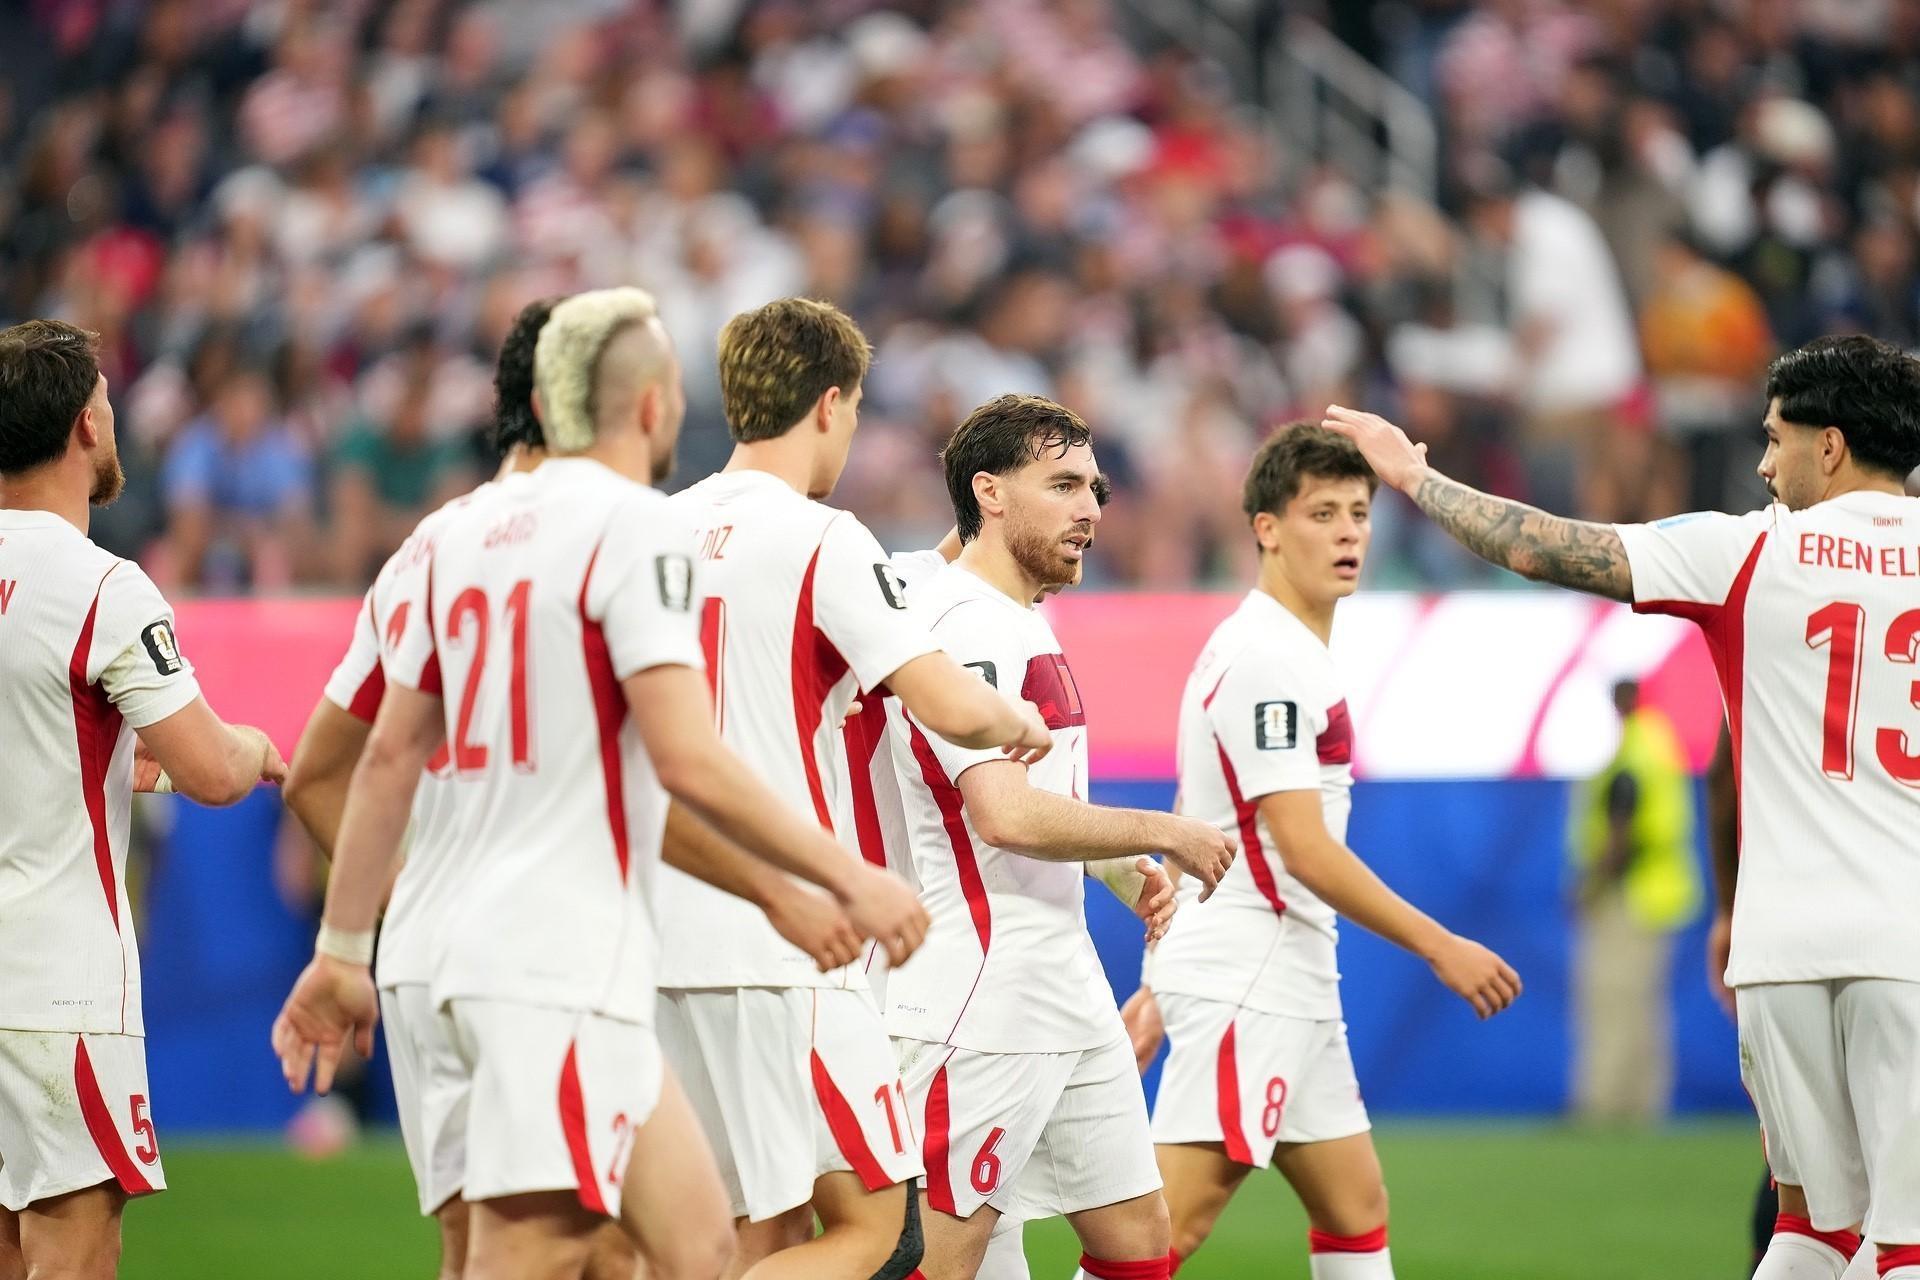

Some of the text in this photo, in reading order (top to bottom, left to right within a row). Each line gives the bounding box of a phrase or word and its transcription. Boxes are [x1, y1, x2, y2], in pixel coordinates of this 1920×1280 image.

[1799, 533, 1920, 577] EREN EL
[446, 578, 537, 779] 21
[1805, 600, 1920, 789] 13
[129, 1094, 159, 1166] 5
[1262, 1075, 1288, 1138] 8
[970, 1126, 1006, 1196] 6
